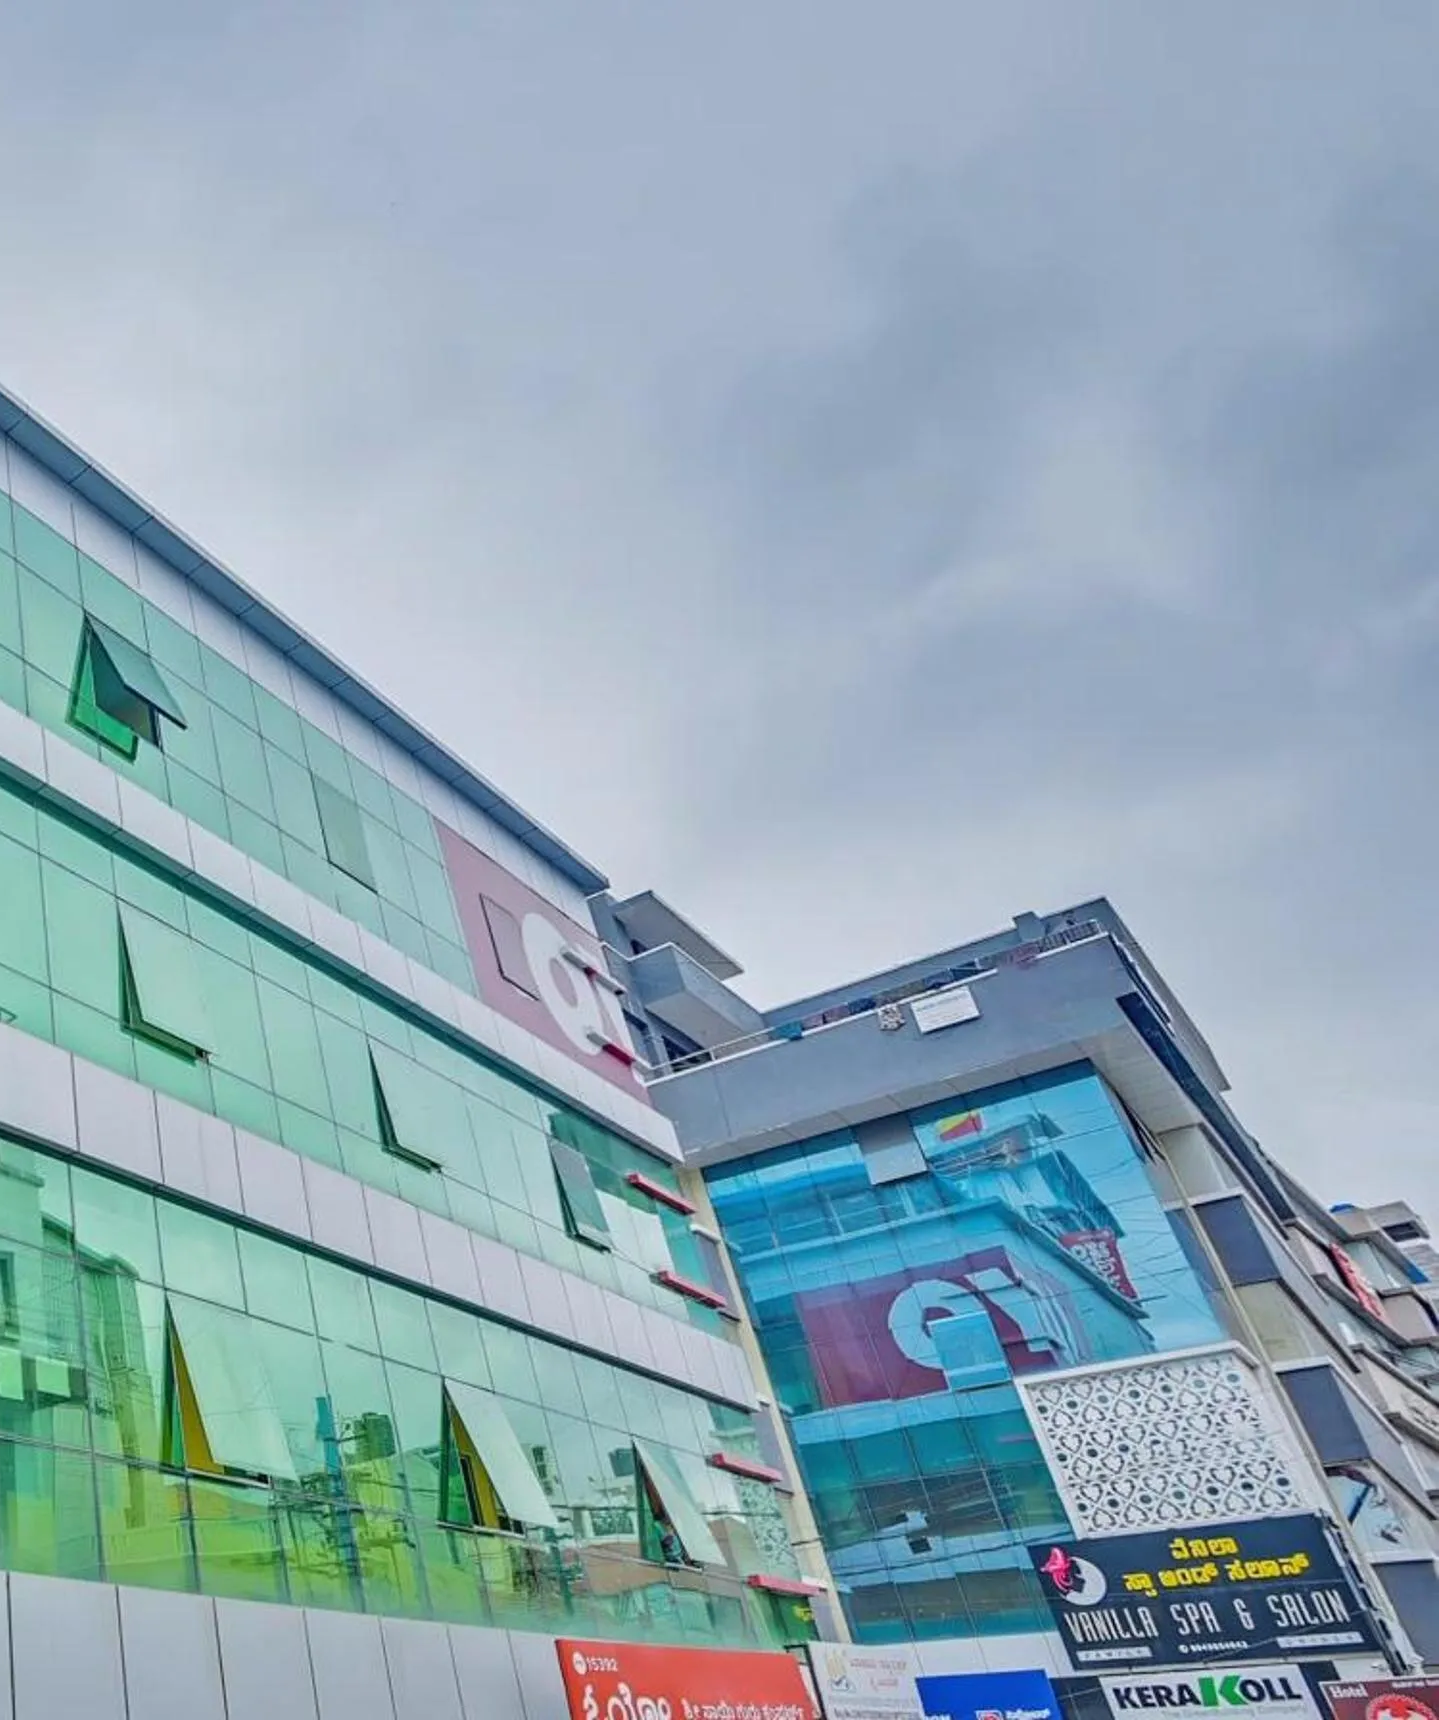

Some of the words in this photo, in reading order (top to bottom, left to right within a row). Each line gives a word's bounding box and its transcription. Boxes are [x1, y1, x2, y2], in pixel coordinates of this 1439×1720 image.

[1064, 1606, 1159, 1643] VANILLA
[1169, 1601, 1222, 1636] SPA
[1233, 1598, 1256, 1631] &
[1266, 1589, 1351, 1628] SALON
[1113, 1675, 1303, 1709] KERAKOLL
